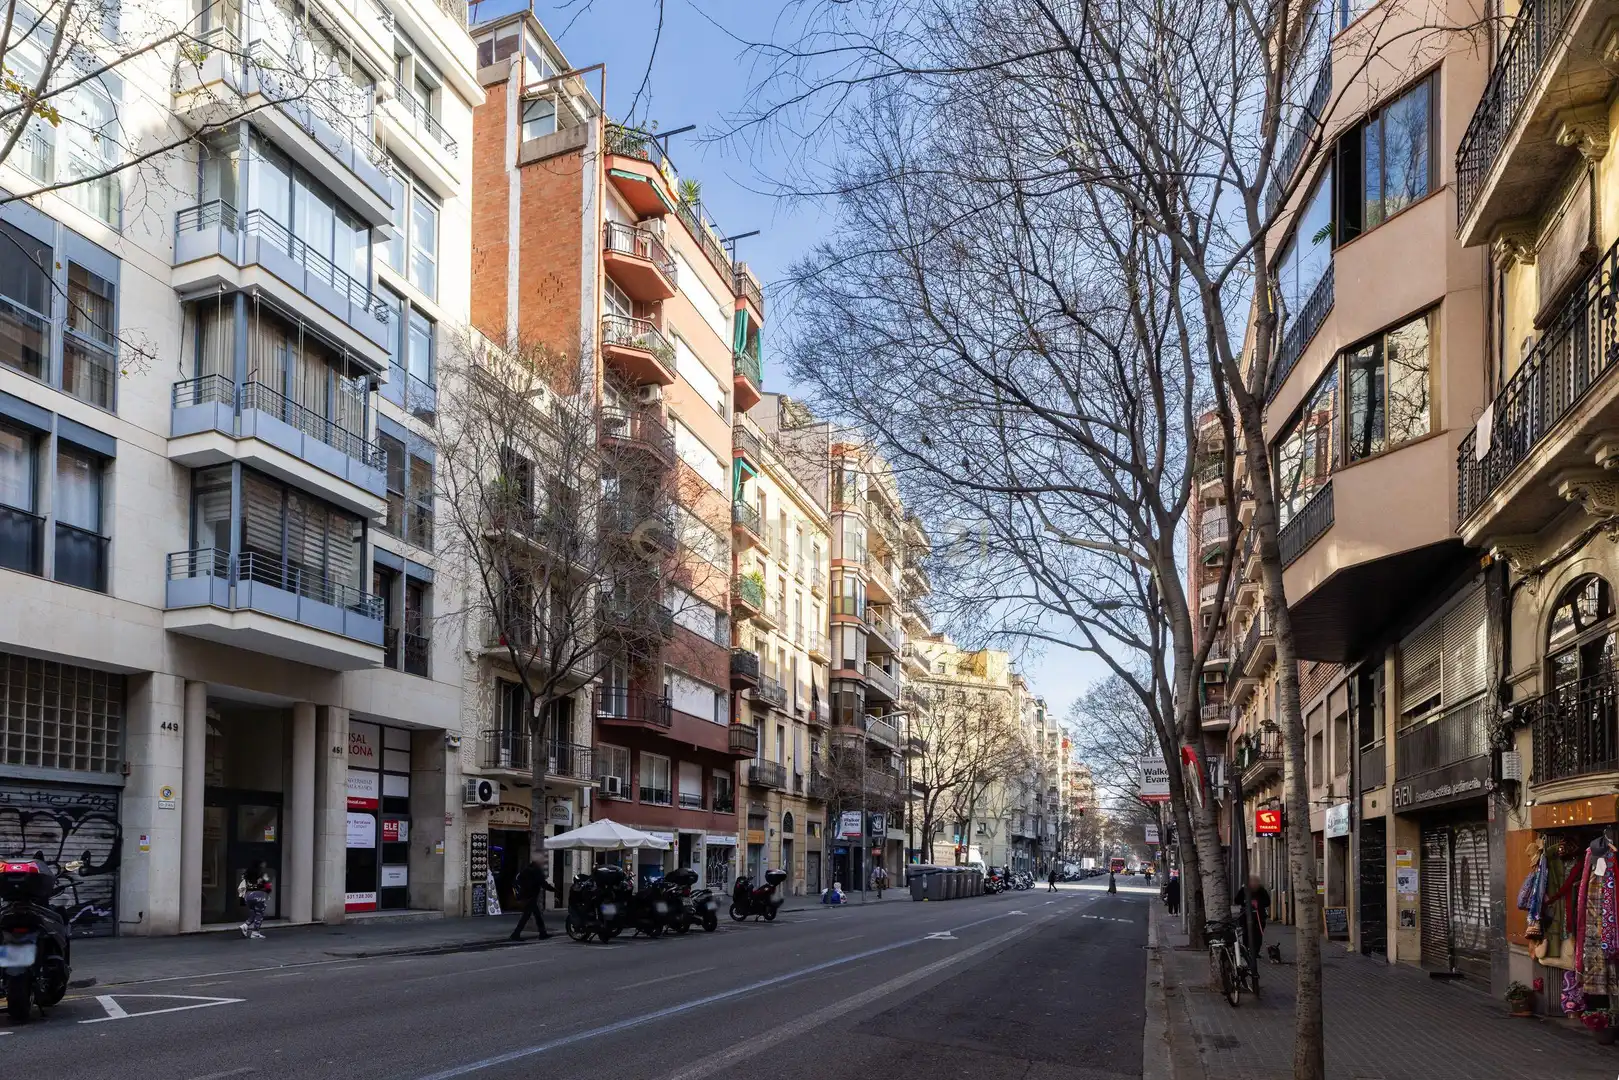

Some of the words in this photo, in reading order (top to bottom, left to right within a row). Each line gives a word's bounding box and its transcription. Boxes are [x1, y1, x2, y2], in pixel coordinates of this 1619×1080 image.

[161, 722, 179, 732] 449
[1395, 785, 1412, 807] EVEN
[384, 822, 398, 831] ELE
